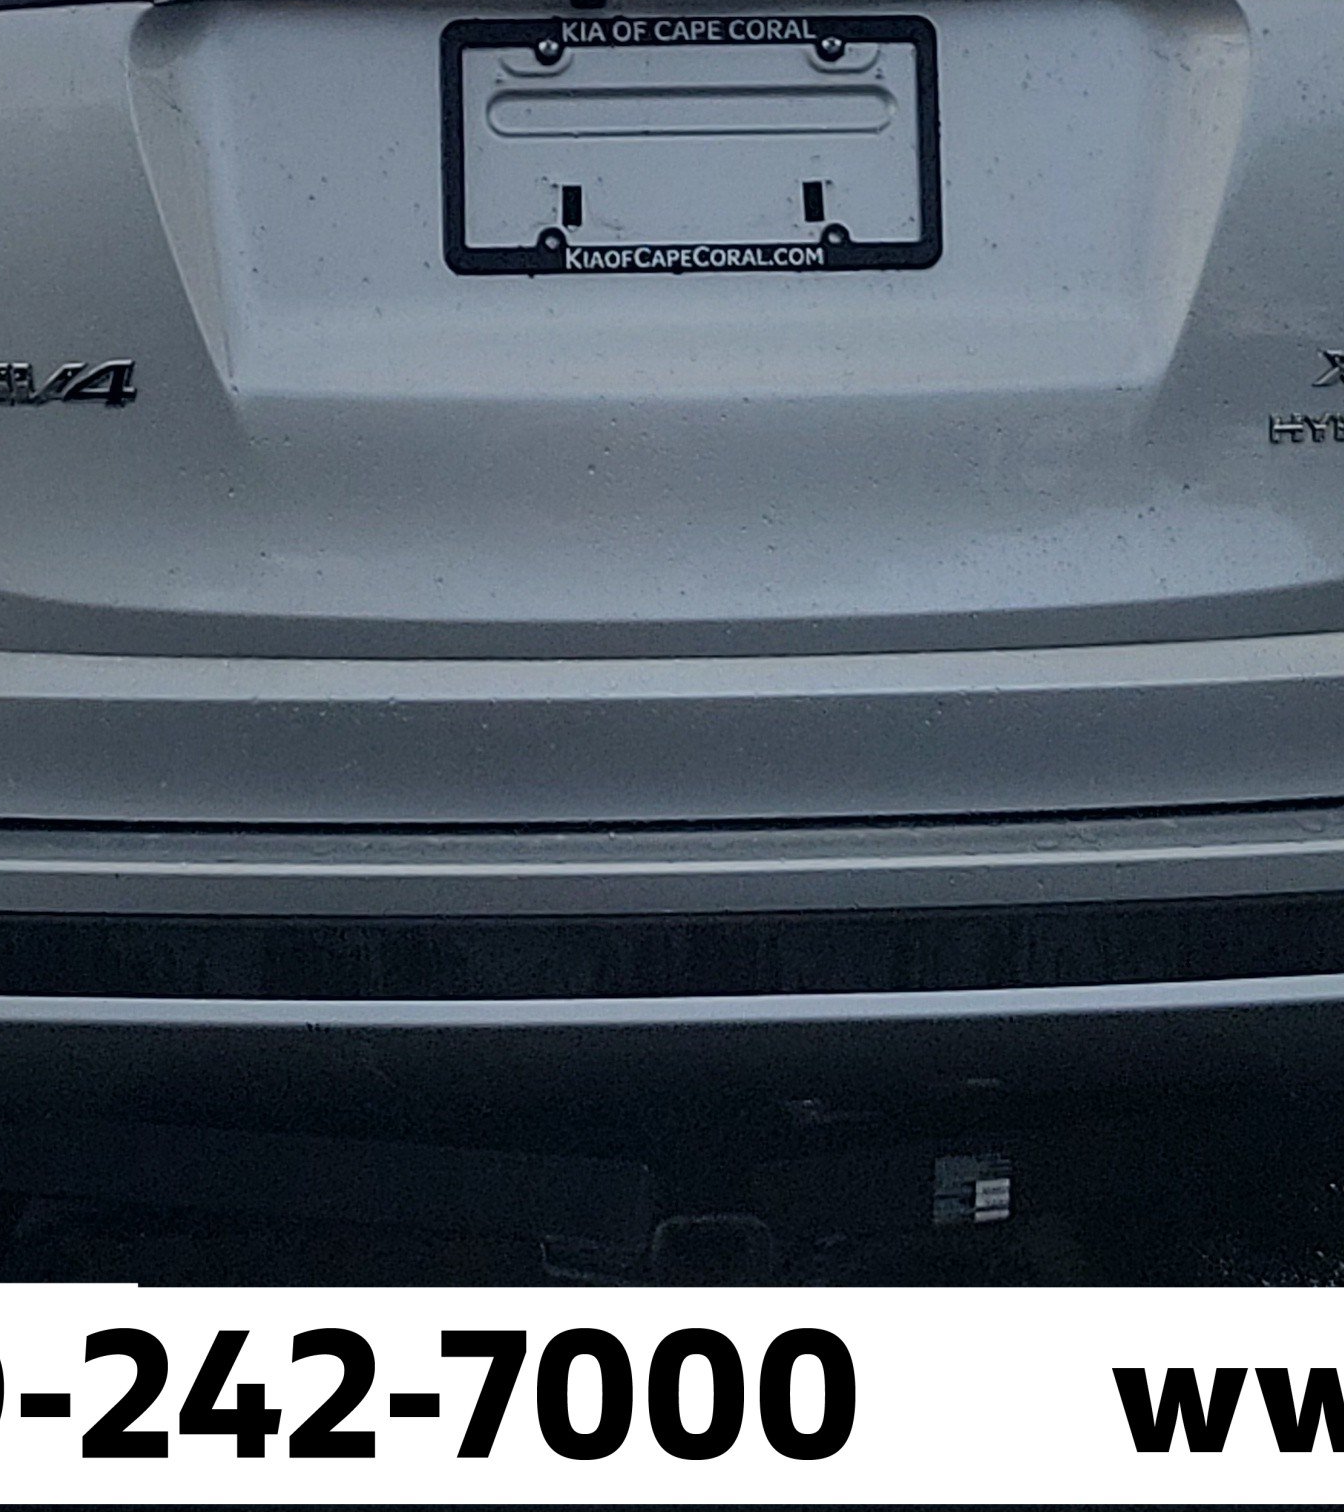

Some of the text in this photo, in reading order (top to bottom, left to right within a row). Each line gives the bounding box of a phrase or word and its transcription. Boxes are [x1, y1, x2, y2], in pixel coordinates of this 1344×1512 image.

[561, 19, 817, 43] KIA OF CAPE CORAL
